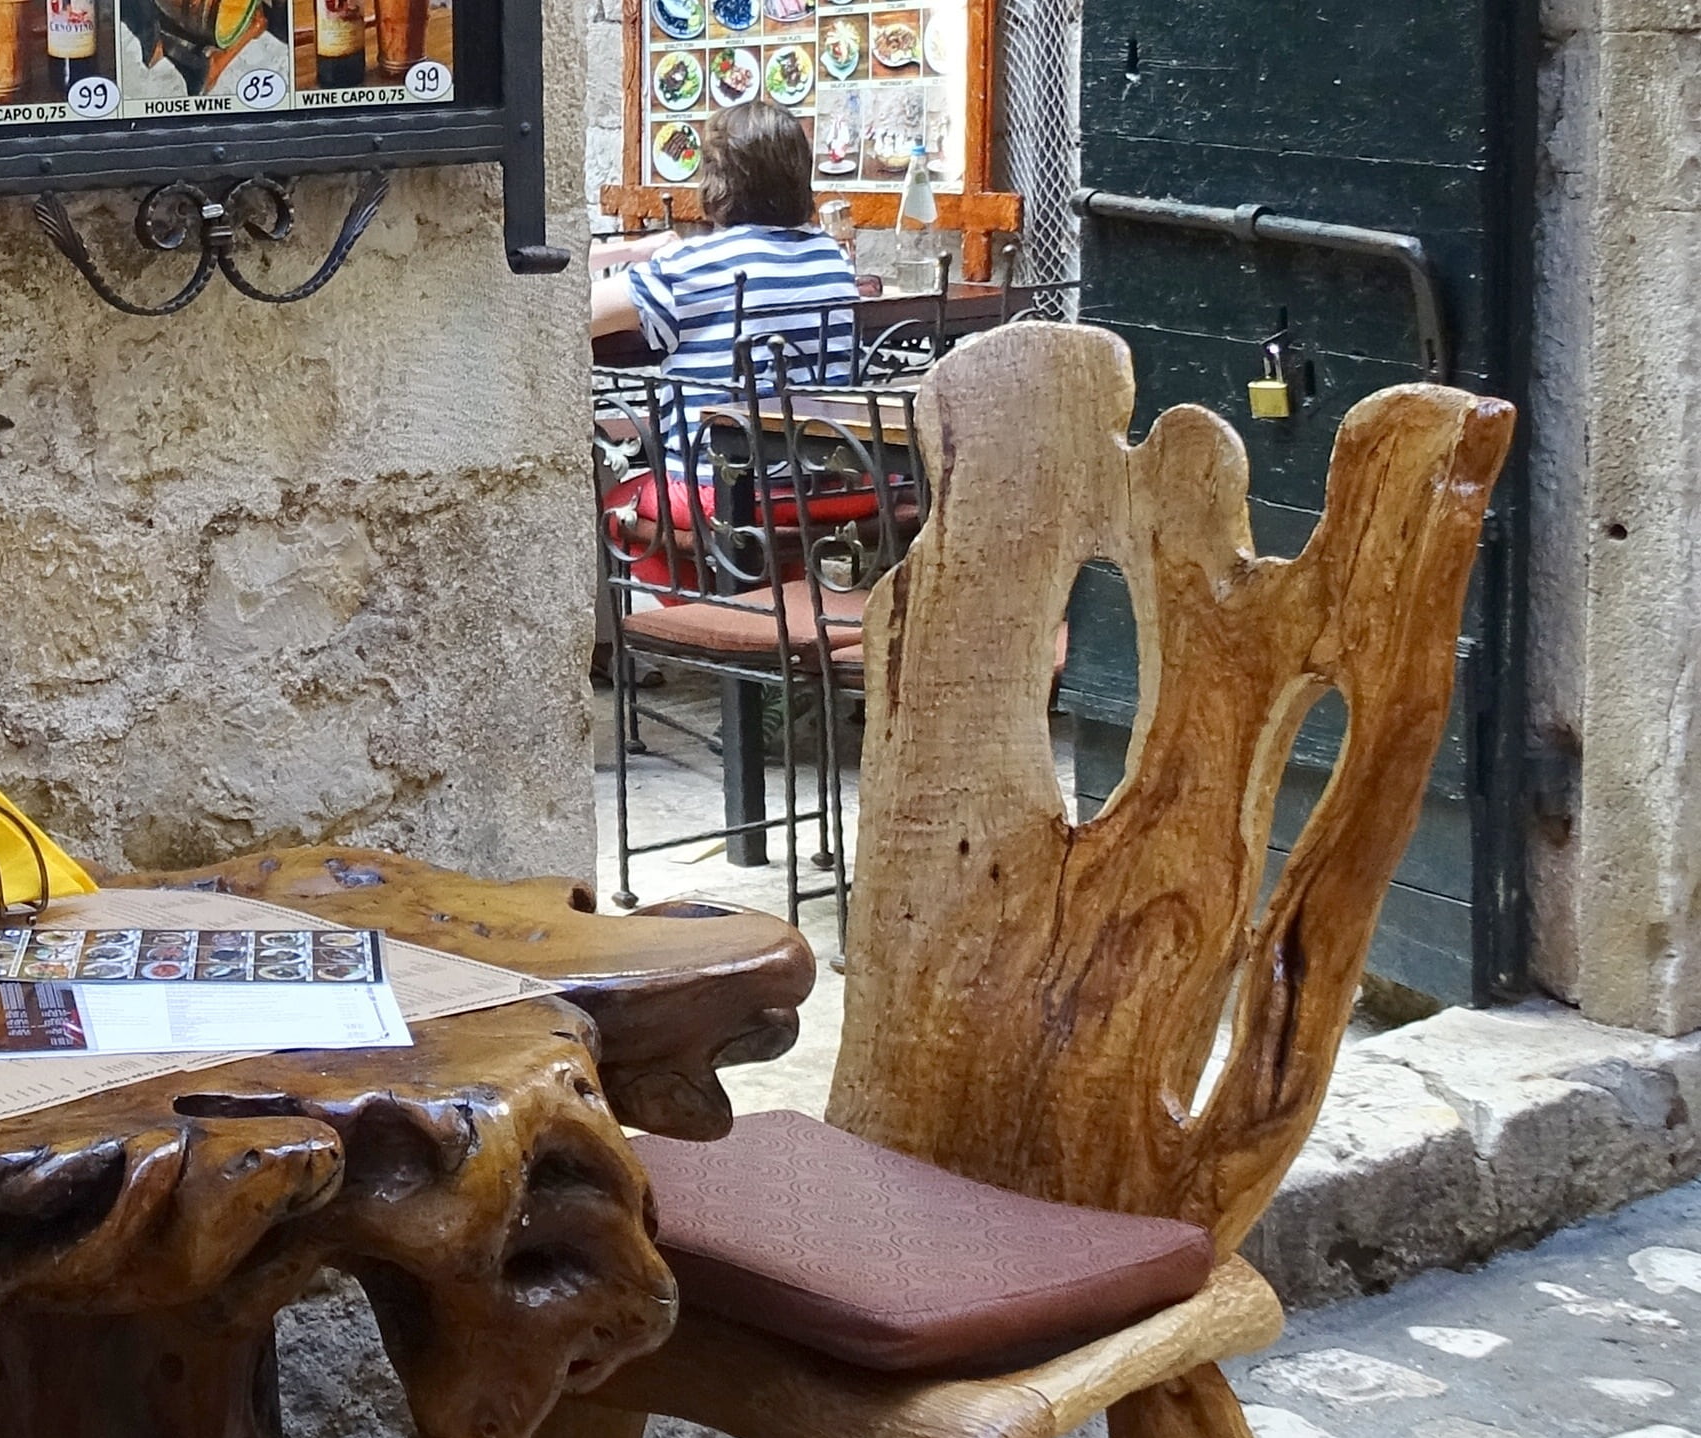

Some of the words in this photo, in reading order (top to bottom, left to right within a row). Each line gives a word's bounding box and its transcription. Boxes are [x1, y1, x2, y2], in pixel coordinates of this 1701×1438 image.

[243, 74, 275, 102] 85
[414, 66, 439, 93] 99
[77, 83, 108, 109] 99
[145, 100, 190, 114] HOUSE
[194, 98, 232, 112] WINE
[302, 92, 338, 105] WINE
[341, 90, 375, 103] CAPO
[378, 88, 405, 104] 0,75
[36, 105, 67, 123] 0,75
